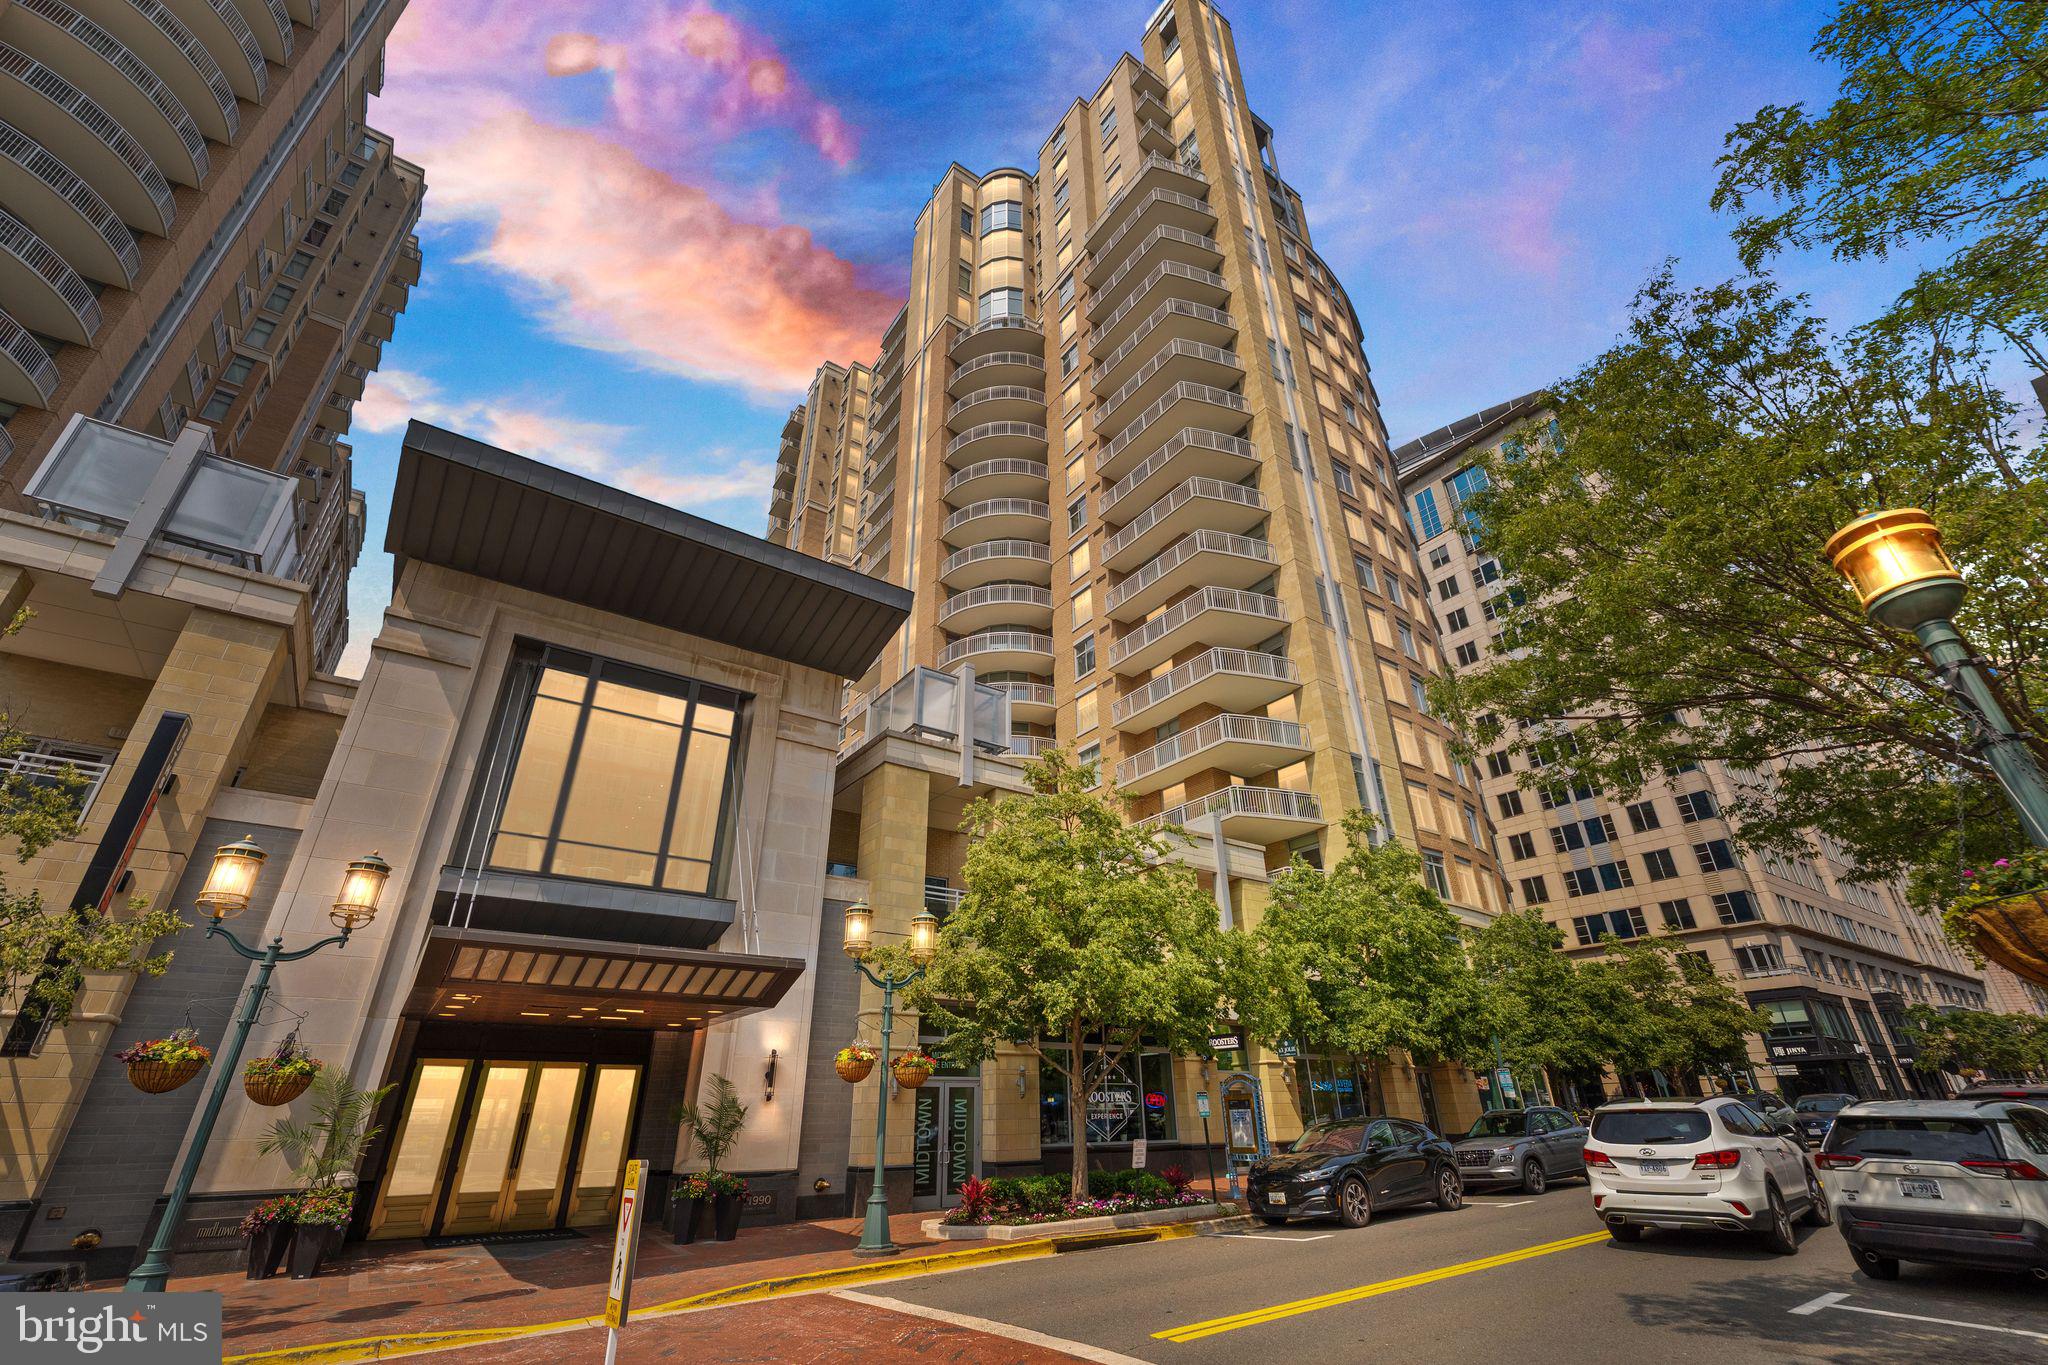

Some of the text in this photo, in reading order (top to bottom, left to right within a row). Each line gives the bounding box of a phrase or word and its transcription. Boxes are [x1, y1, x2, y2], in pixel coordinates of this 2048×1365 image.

[1786, 1047, 1808, 1056] JINYA
[1145, 1093, 1166, 1107] OPEN
[915, 1098, 932, 1184] MIDTOWN
[952, 1099, 968, 1183] MIDTOWN
